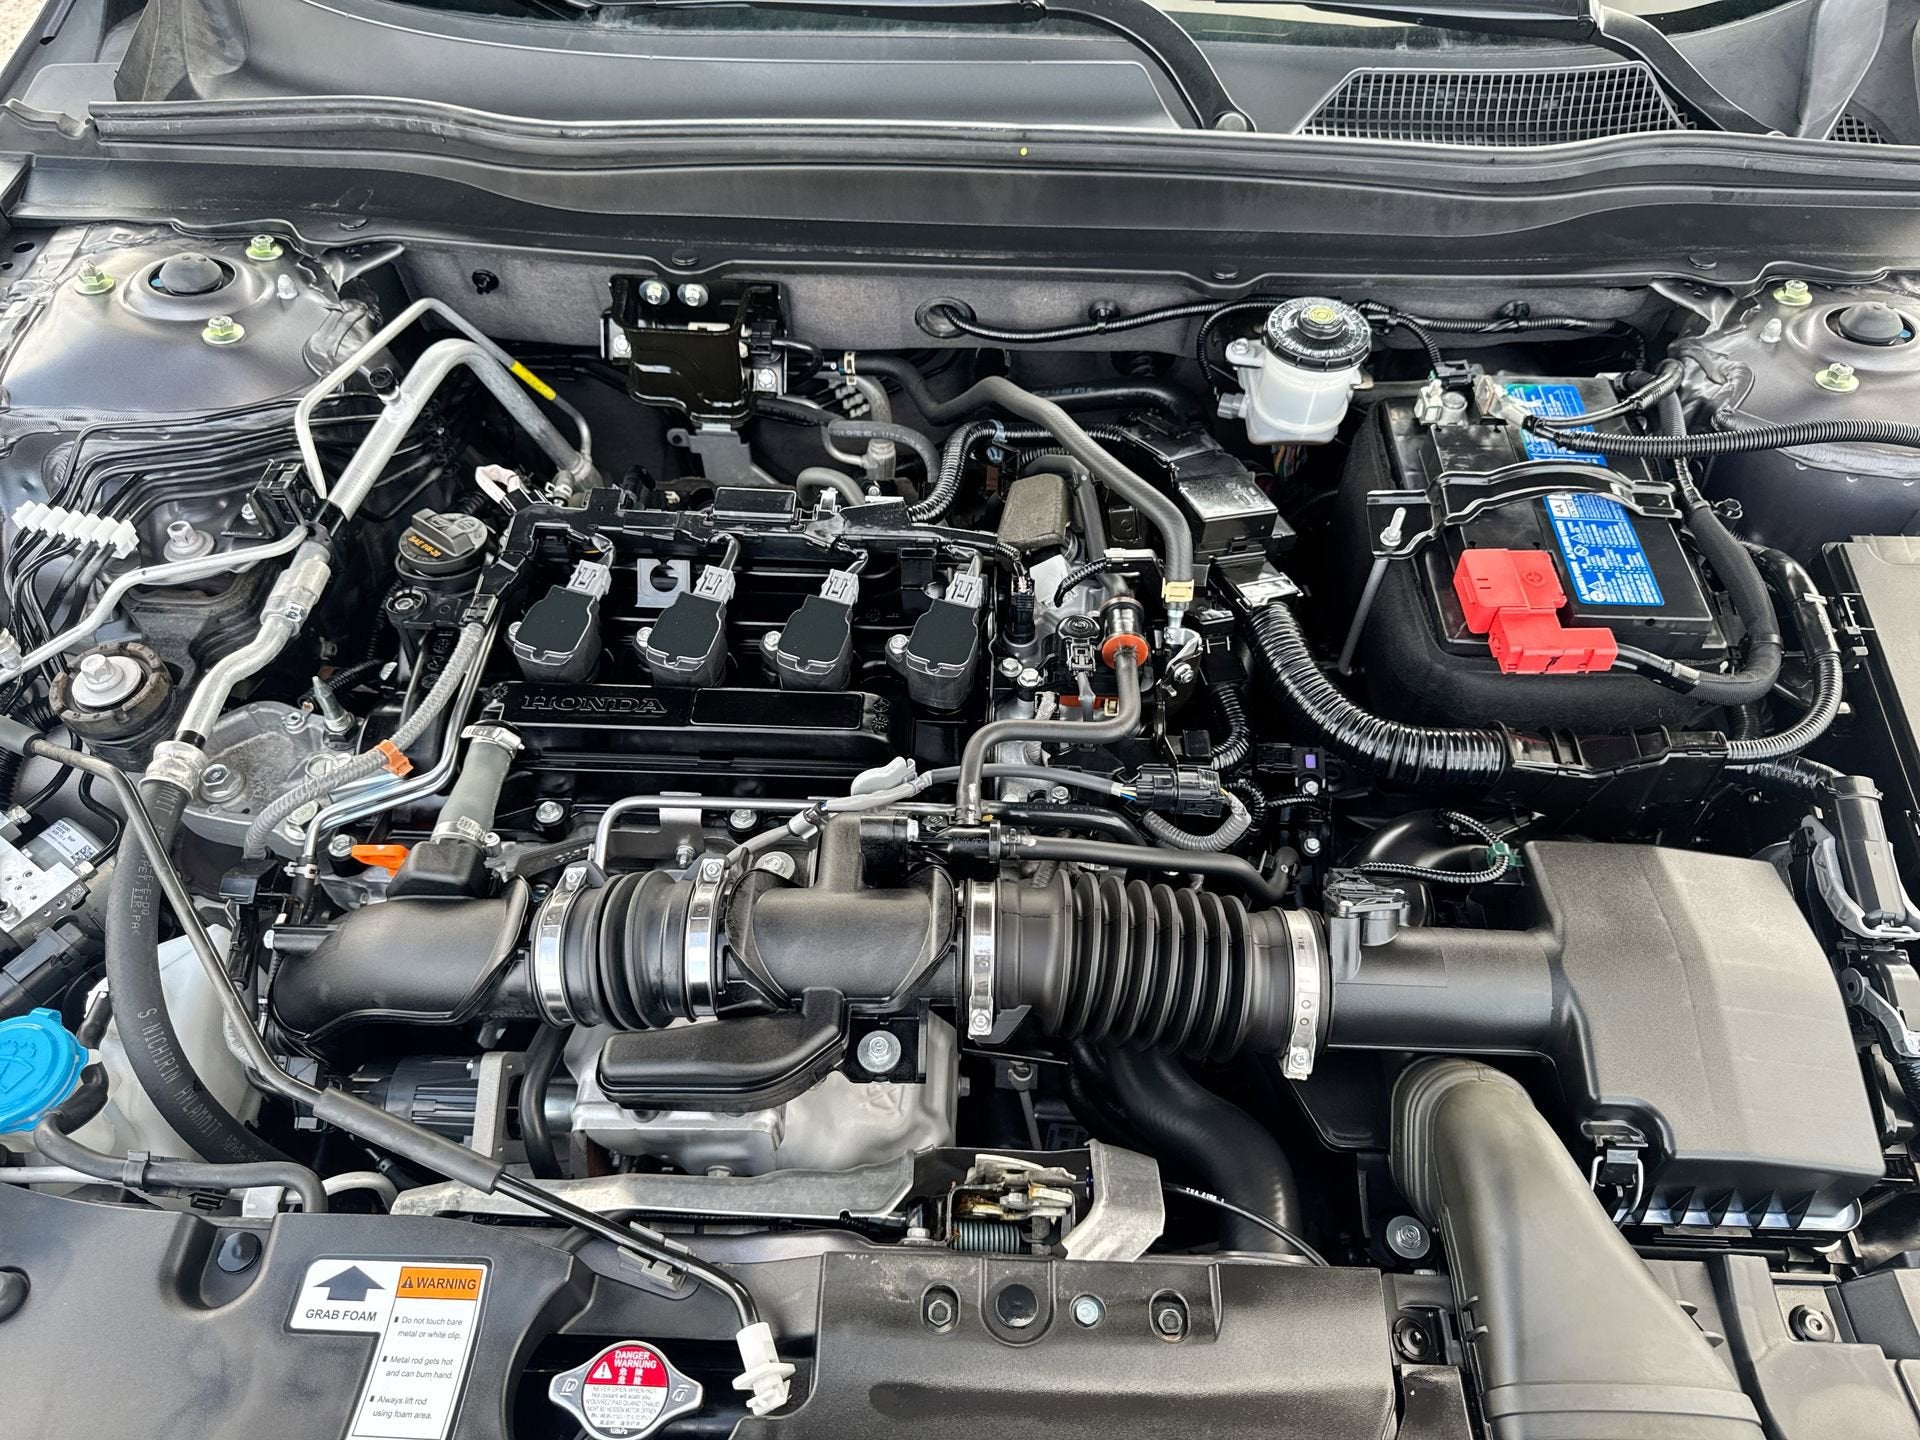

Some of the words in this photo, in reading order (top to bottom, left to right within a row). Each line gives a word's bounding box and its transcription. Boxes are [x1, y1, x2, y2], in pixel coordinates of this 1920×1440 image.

[408, 535, 425, 547] SAE
[521, 694, 668, 714] HONDA
[415, 1276, 477, 1290] WARNING
[305, 1308, 339, 1320] GRAB
[342, 1310, 378, 1322] FOAM
[401, 1316, 412, 1324] Do
[426, 1317, 446, 1325] touch
[446, 1317, 463, 1325] bare
[427, 1331, 446, 1339] white
[447, 1332, 461, 1340] clip.
[614, 1350, 650, 1360] DANGER
[389, 1355, 410, 1364] Metal
[411, 1356, 423, 1364] rod
[424, 1357, 440, 1366] gets
[441, 1358, 453, 1366] hot
[613, 1359, 657, 1369] WARNUNG
[385, 1369, 401, 1377] and
[415, 1370, 432, 1378] burn
[433, 1371, 453, 1379] hand.
[376, 1395, 403, 1405] Always
[404, 1396, 413, 1405] lift
[414, 1397, 428, 1405] rod
[372, 1410, 392, 1419] using
[393, 1409, 413, 1418] foam
[413, 1411, 432, 1419] area.
